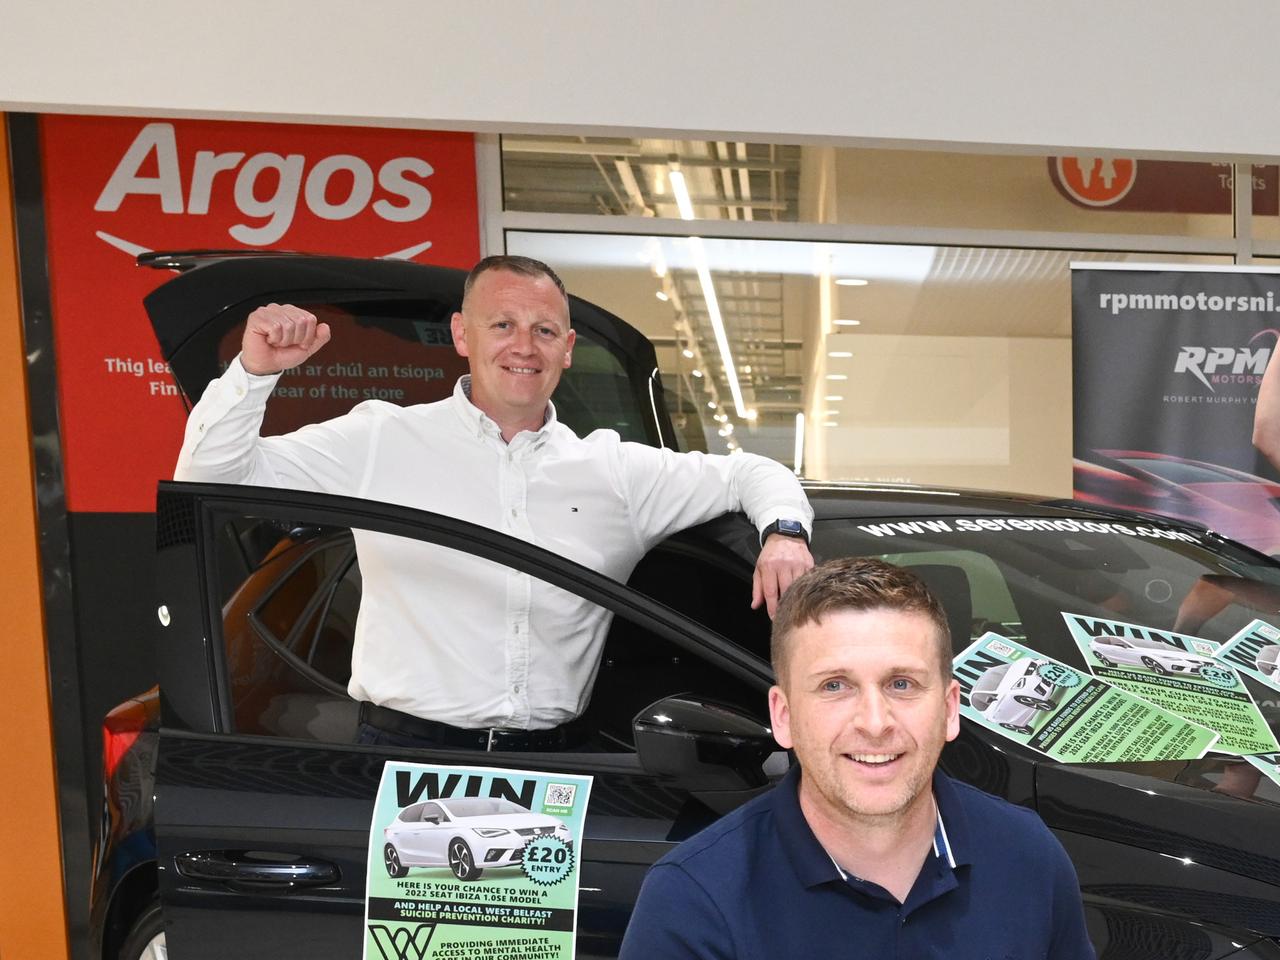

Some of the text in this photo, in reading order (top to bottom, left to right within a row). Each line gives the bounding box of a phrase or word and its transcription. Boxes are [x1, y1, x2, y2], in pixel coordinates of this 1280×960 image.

[95, 122, 434, 246] Argos
[105, 359, 144, 376] Thig
[306, 366, 322, 377] ar
[327, 363, 362, 377] chúl
[368, 366, 388, 378] an
[394, 365, 444, 381] tsiopa
[1174, 346, 1271, 393] RPM
[1212, 375, 1262, 384] MOTORS
[150, 382, 185, 397] Fin
[309, 383, 326, 398] of
[331, 383, 358, 398] the
[363, 386, 404, 400] store
[857, 517, 1202, 544] www.seremotors.com
[1074, 617, 1189, 651] WIN
[396, 771, 537, 810] WIN
[528, 846, 567, 864] £20
[531, 865, 561, 873] ENTRY
[397, 881, 419, 890] HERE
[434, 883, 460, 892] YOUR
[463, 885, 500, 894] CHANCE
[519, 888, 538, 897] WIN
[541, 889, 548, 897] A
[405, 889, 427, 898] 2022
[430, 890, 452, 899] SEAT
[455, 892, 481, 901] IBIZA
[510, 895, 541, 904] MODEL
[394, 902, 552, 918] AND HELP A LOCAL WEST BELFAST
[400, 910, 545, 926] SUICIDE PREVENTION CHARITY!
[432, 944, 561, 958] ACCESS TO MENTAL HEALTH
[440, 938, 549, 949] PROVIDING IMMEDIATE
